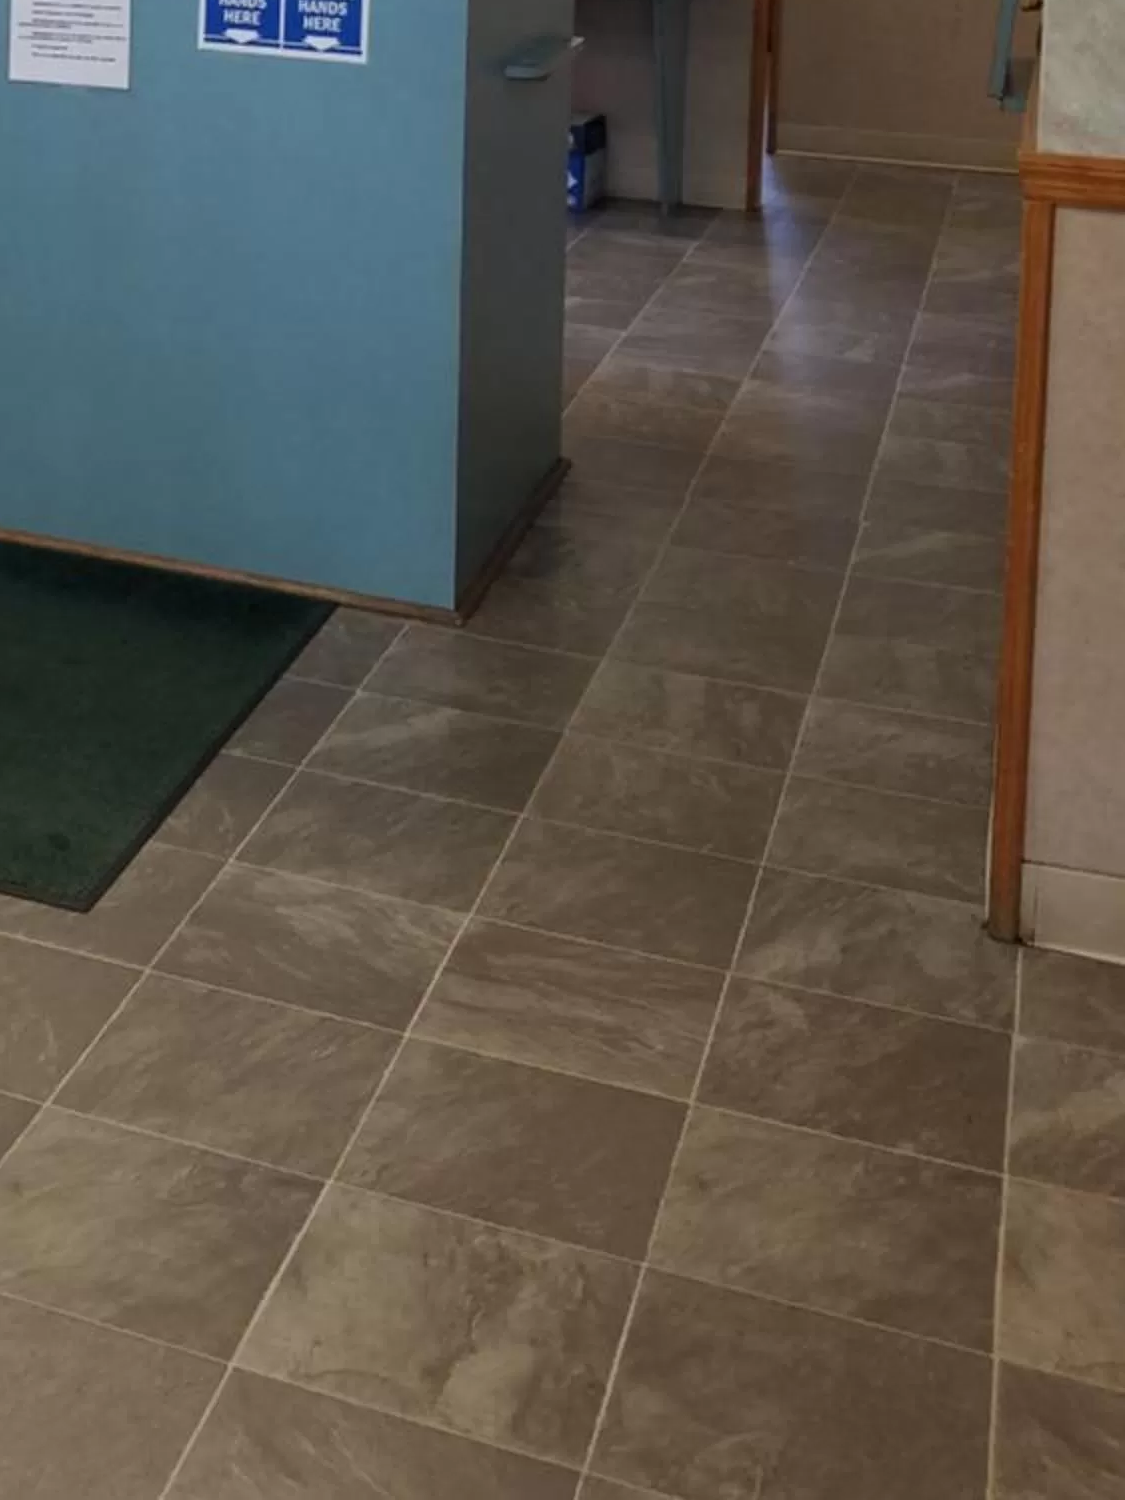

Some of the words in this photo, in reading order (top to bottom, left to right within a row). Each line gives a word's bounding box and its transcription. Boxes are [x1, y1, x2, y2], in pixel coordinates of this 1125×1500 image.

[298, 0, 348, 17] HANDS
[223, 9, 262, 26] HERE
[302, 15, 342, 33] HERE
